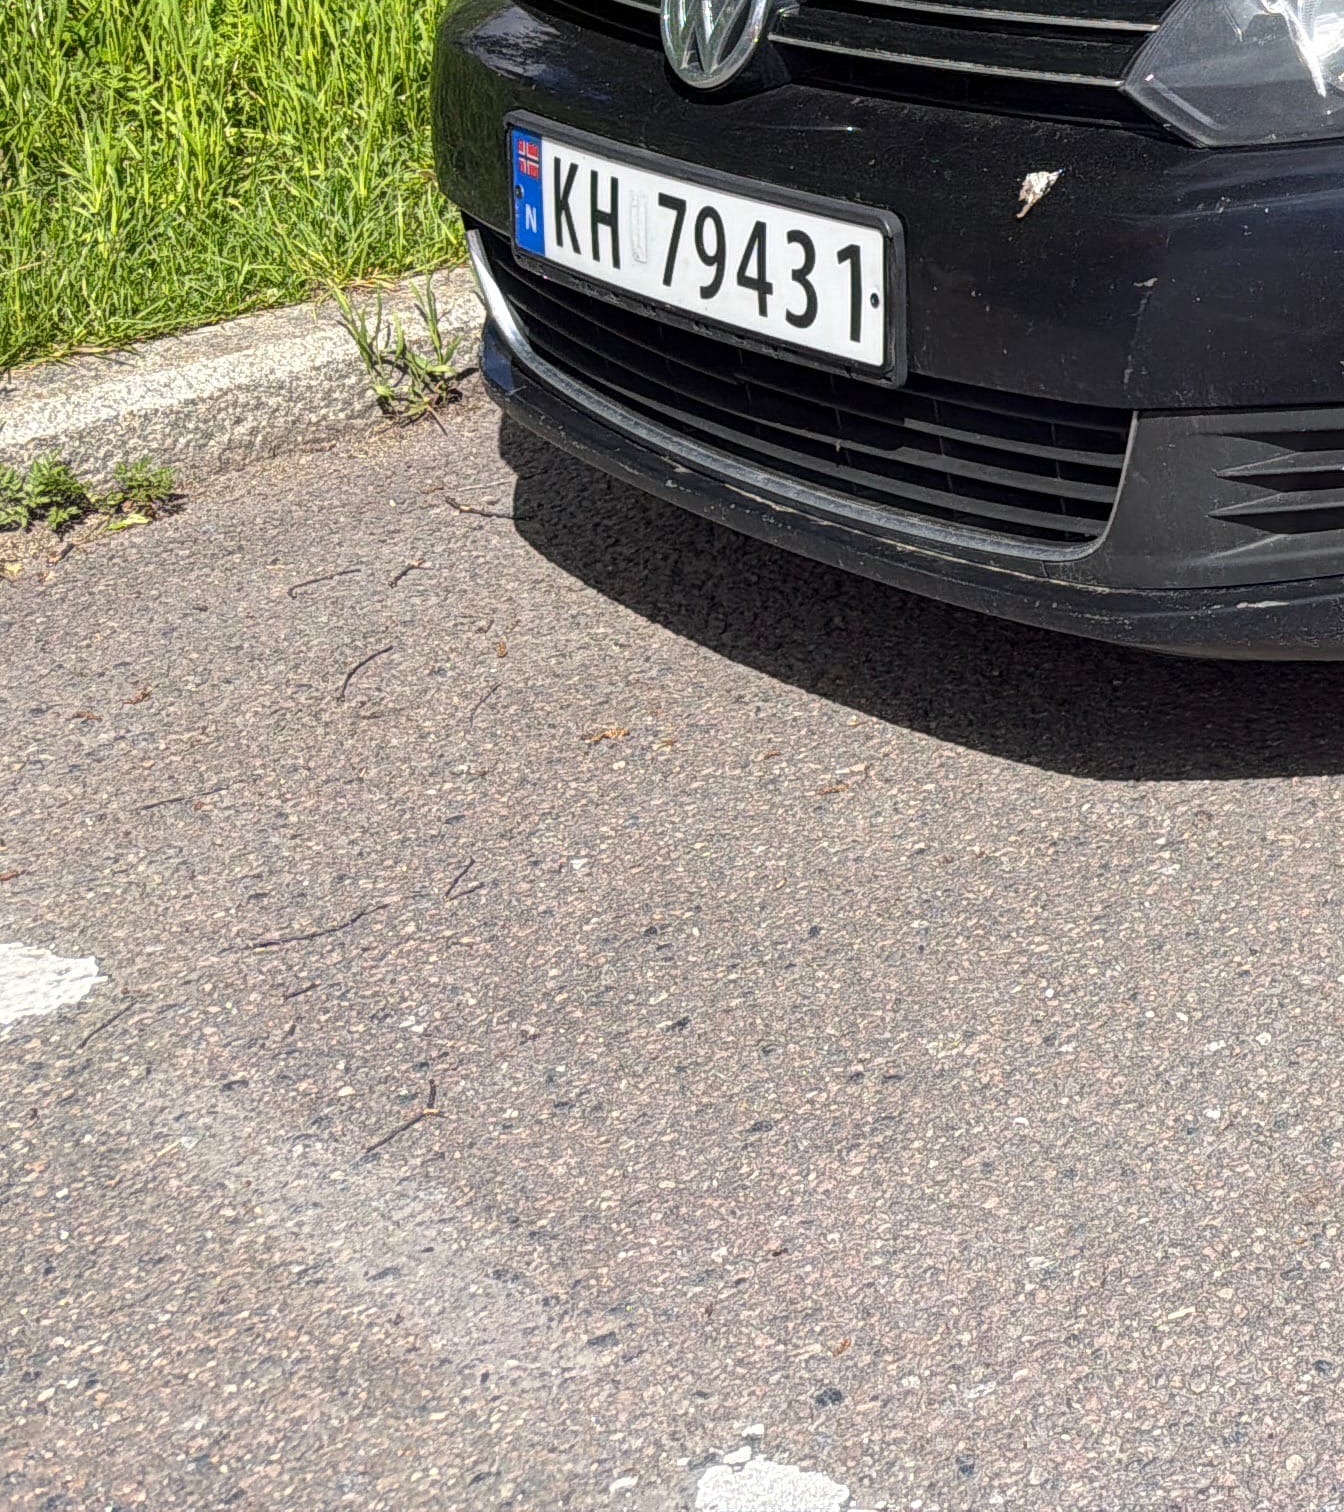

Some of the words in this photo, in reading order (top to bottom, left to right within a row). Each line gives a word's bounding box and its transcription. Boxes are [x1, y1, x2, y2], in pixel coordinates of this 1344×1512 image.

[525, 203, 538, 234] N
[553, 155, 622, 270] KH
[656, 192, 863, 344] 79431
